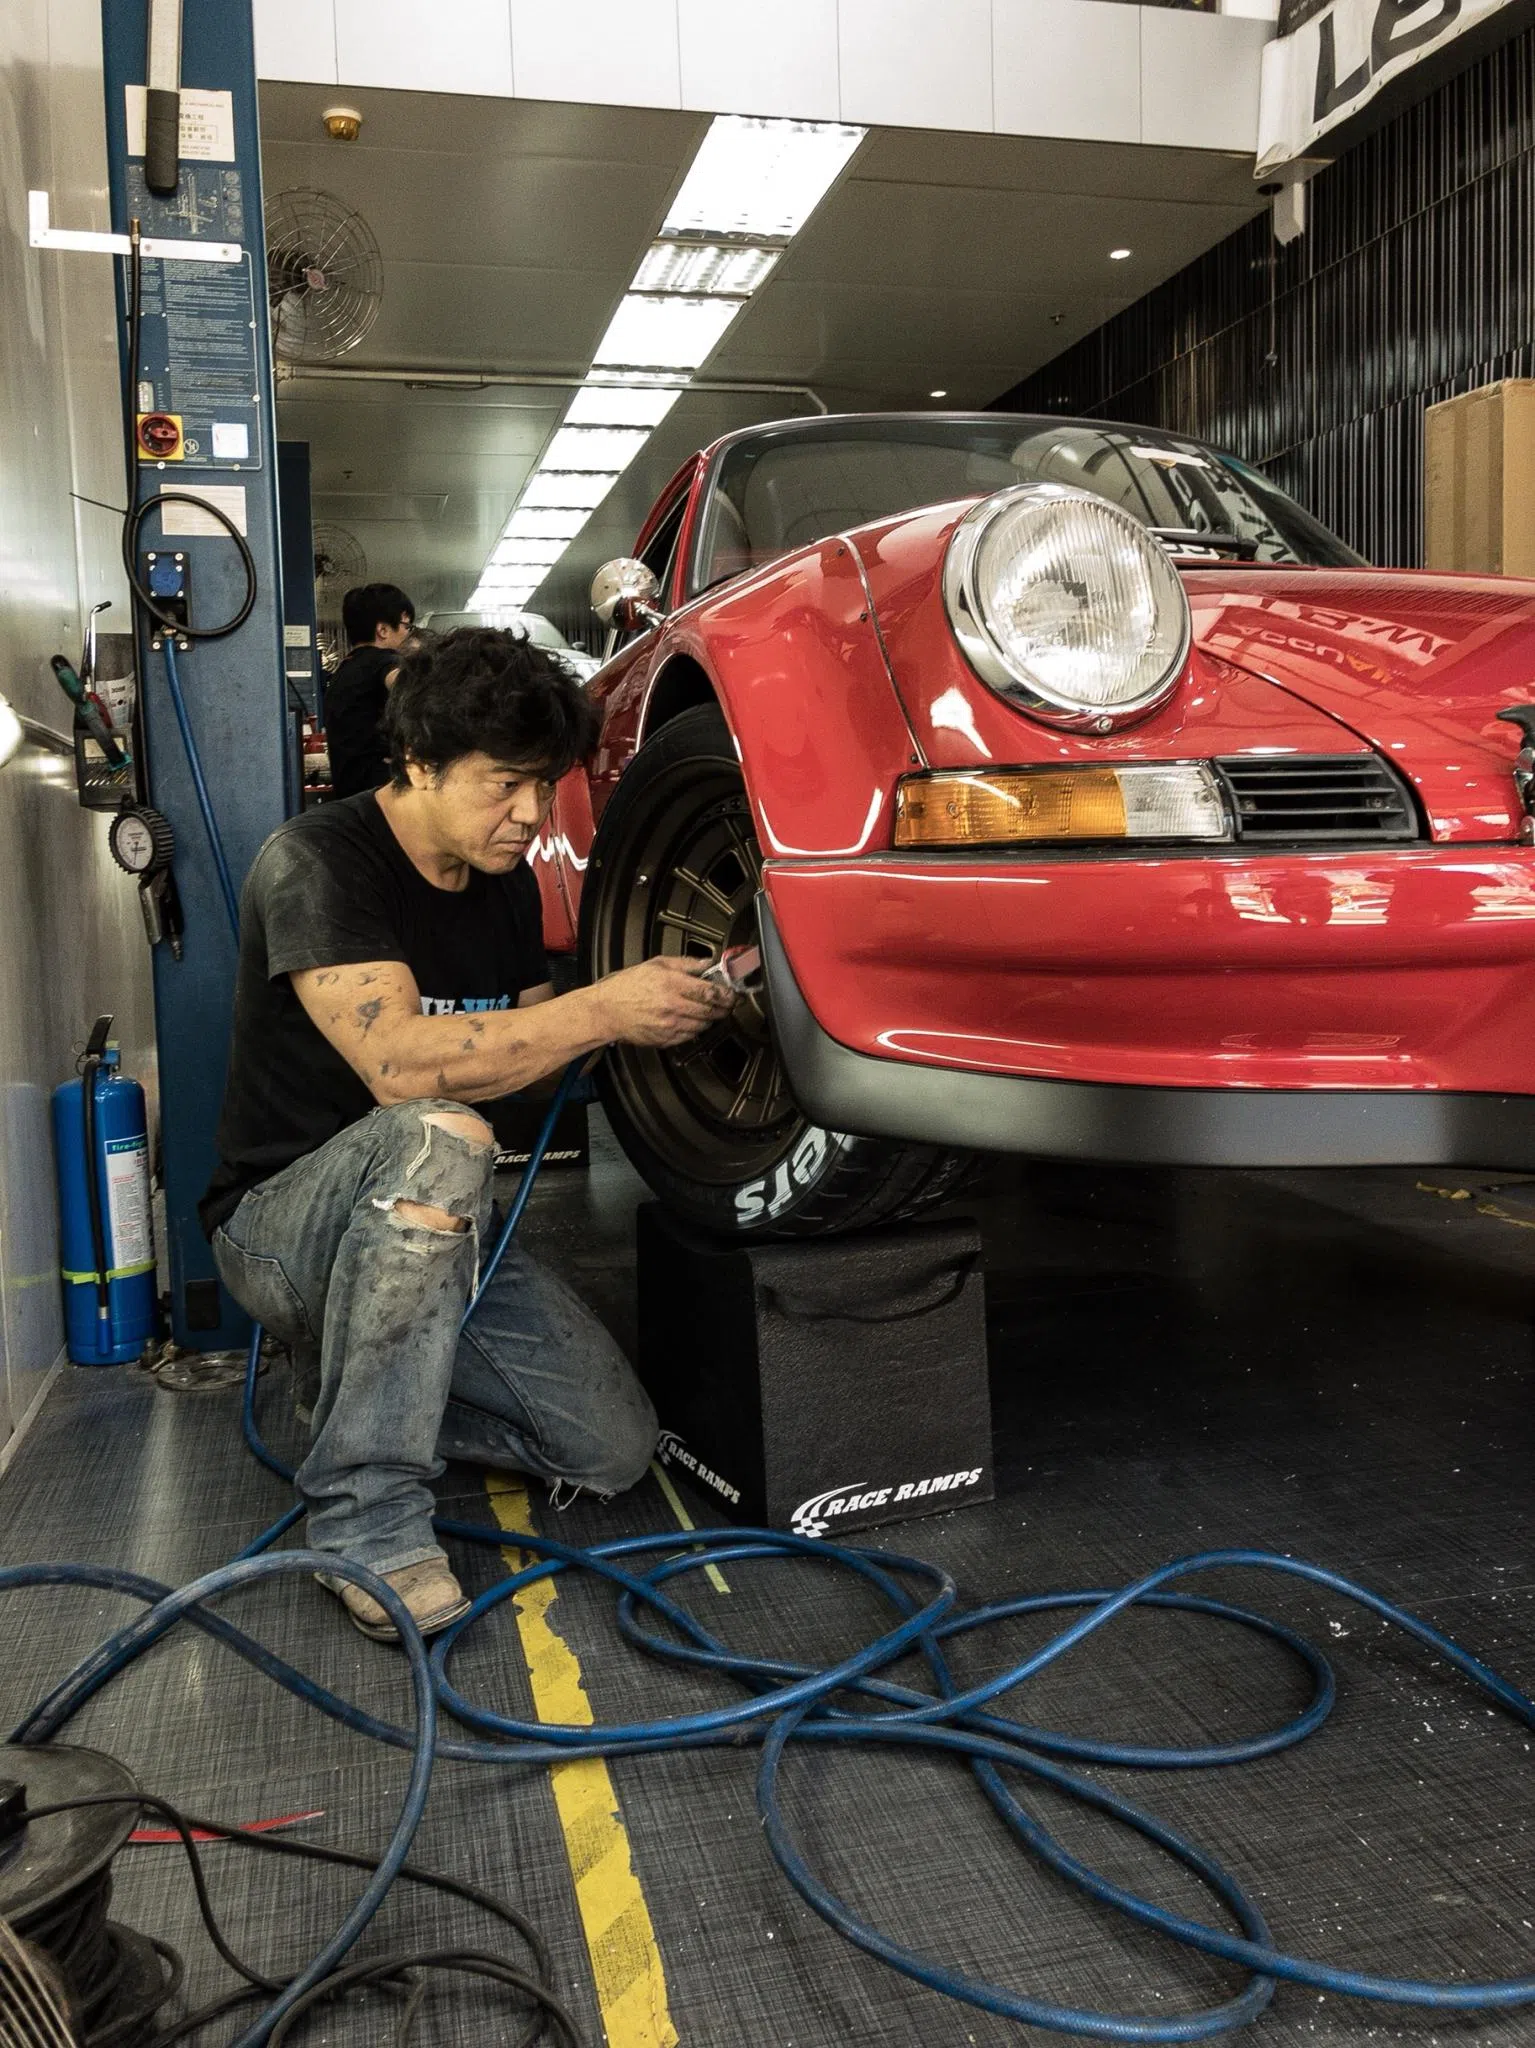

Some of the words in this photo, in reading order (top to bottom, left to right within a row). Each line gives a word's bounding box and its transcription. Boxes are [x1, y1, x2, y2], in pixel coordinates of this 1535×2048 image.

[494, 1153, 532, 1164] RACE
[542, 1150, 582, 1160] AMPS
[668, 1441, 698, 1472] RACE
[696, 1463, 741, 1505] RAMPS
[823, 1487, 893, 1518] RACE
[893, 1467, 983, 1502] RAMPS
